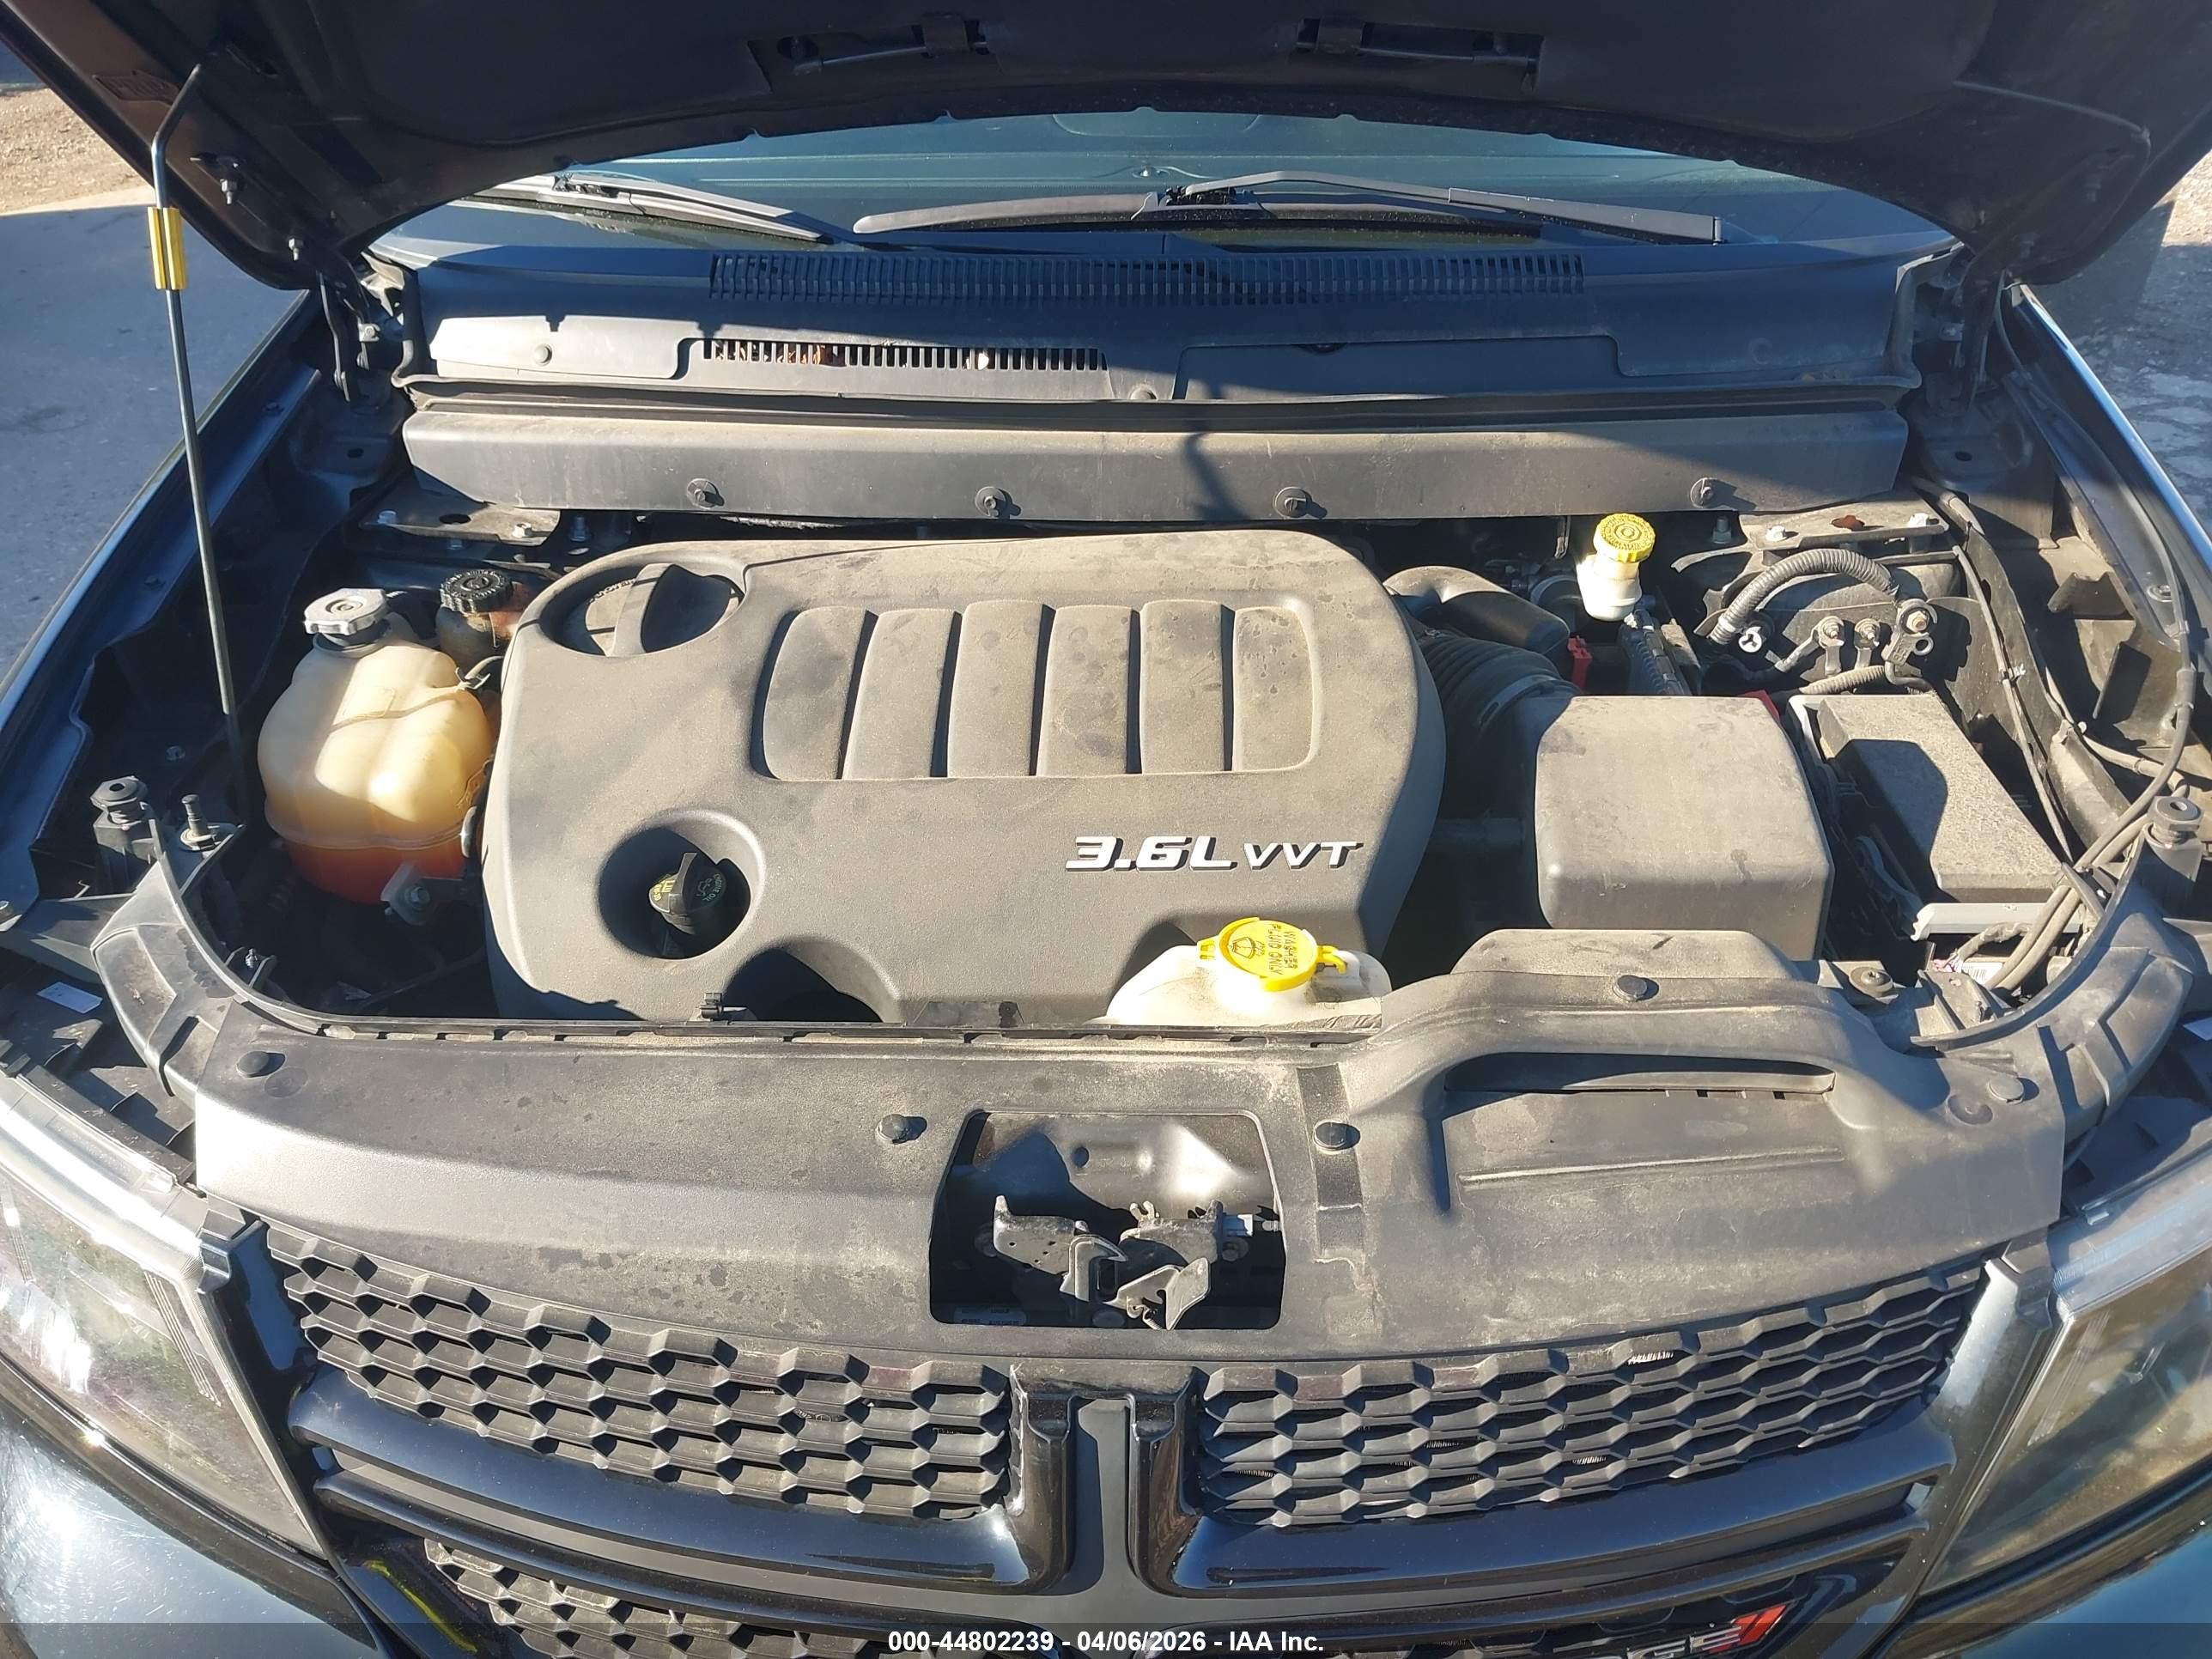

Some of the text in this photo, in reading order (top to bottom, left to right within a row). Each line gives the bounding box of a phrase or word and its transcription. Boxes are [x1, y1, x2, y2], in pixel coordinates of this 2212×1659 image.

[1066, 836, 1364, 872] 3.6L VVT
[702, 892, 718, 902] OIL
[1267, 923, 1283, 975] FLUID ONLY
[1283, 930, 1298, 969] WASHER
